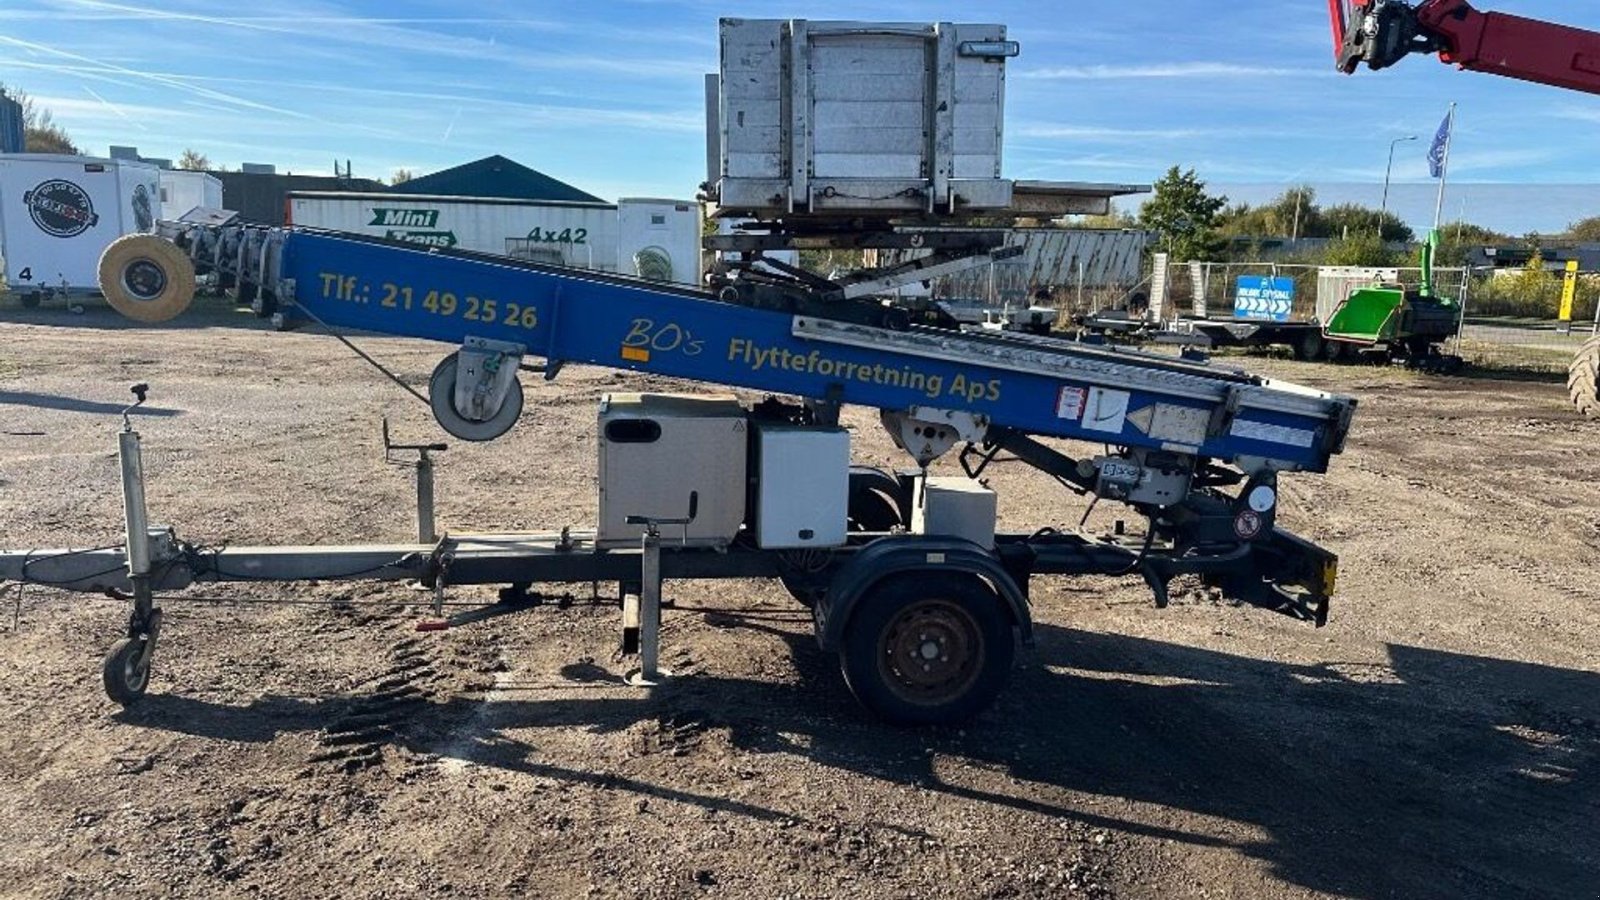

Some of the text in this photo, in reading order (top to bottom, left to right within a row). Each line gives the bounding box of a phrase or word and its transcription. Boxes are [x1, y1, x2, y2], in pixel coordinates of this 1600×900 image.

[382, 210, 433, 226] Mini
[528, 227, 588, 244] 4x42
[19, 267, 32, 281] 4
[319, 273, 538, 329] Tlf.: 21 49 25 26
[728, 337, 1002, 404] Flytteforretning ApS
